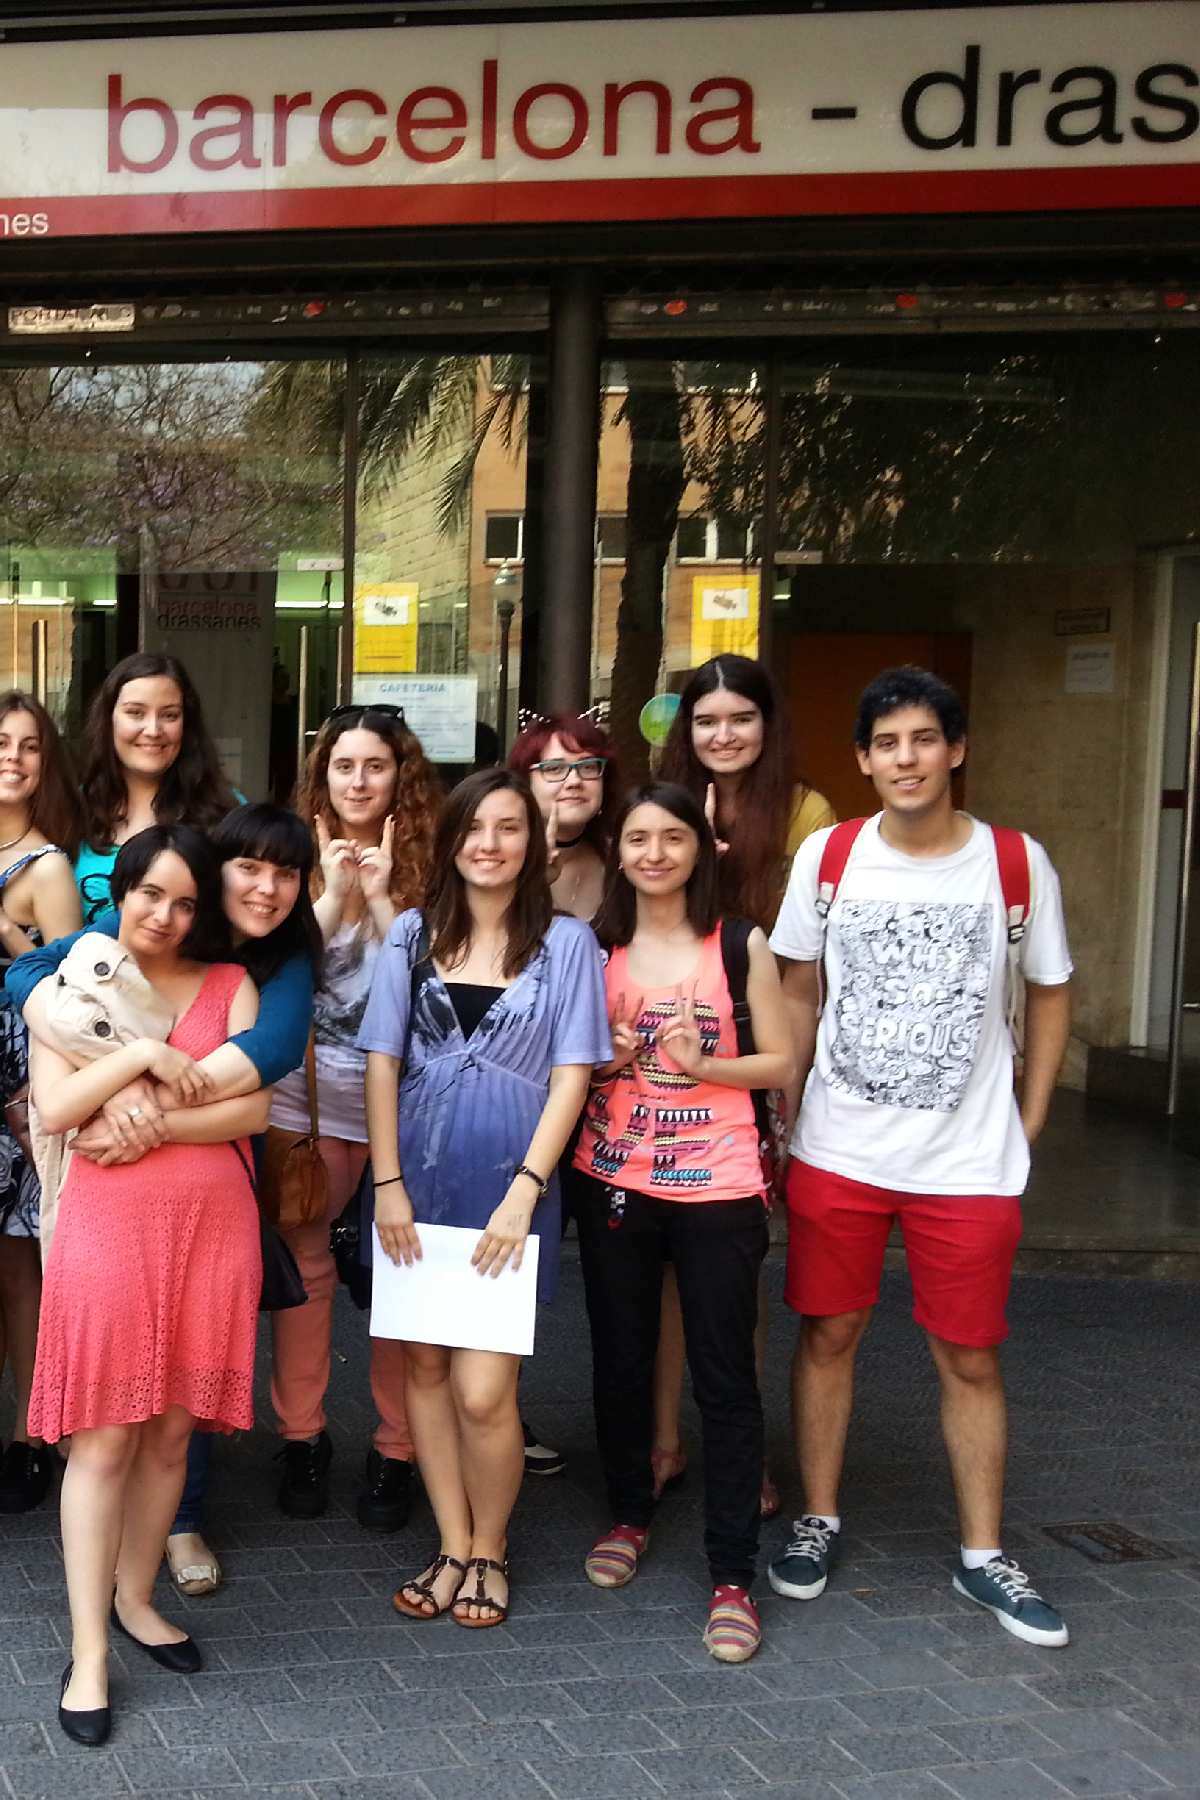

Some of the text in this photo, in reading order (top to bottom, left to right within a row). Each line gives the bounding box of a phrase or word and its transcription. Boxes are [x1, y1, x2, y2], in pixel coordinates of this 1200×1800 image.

[105, 59, 762, 174] barcelona
[901, 45, 1200, 150] dras
[839, 1011, 971, 1058] SERIOUS
